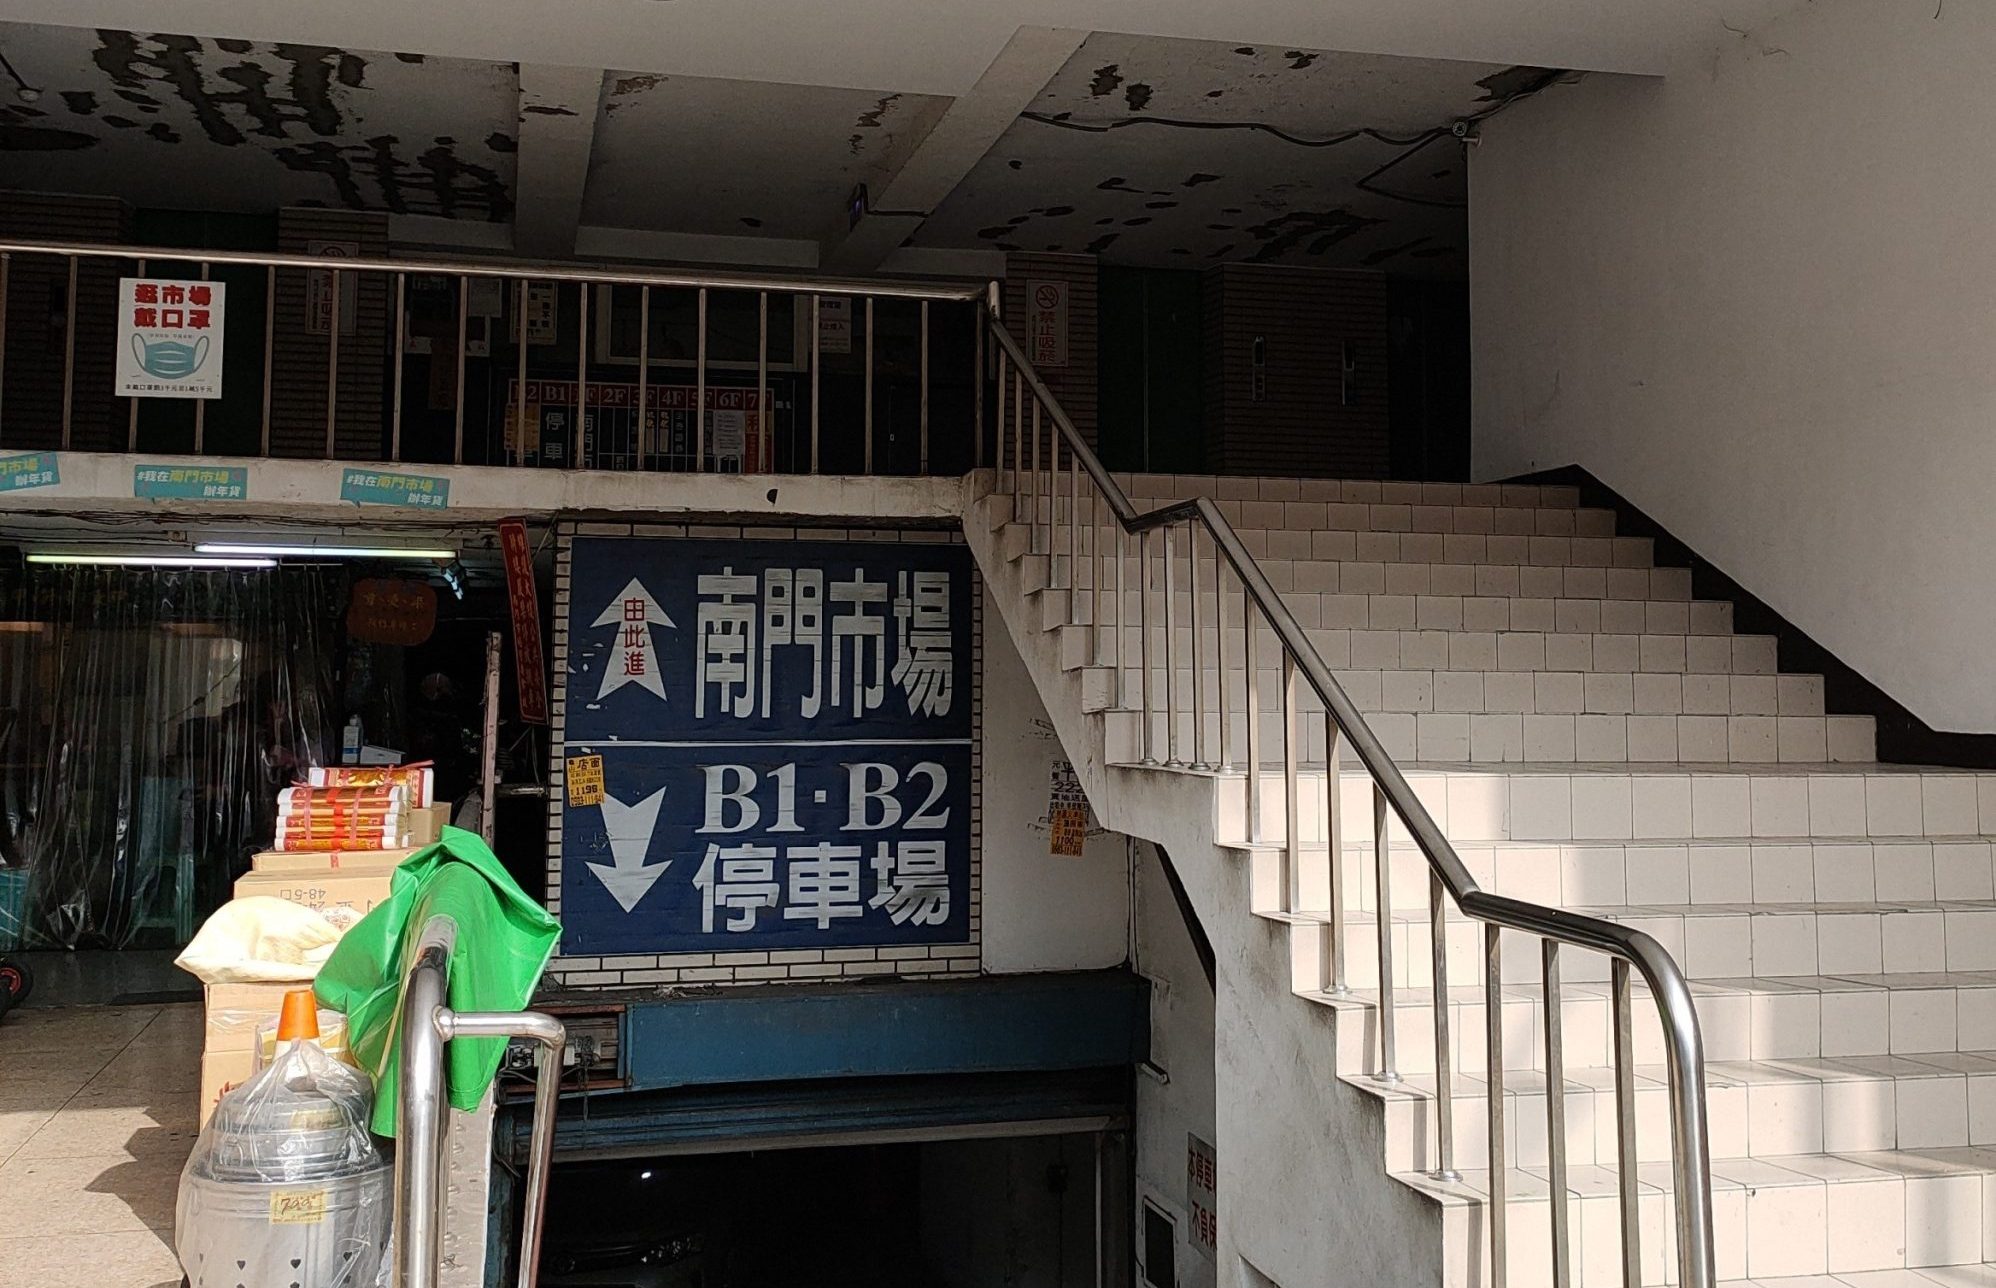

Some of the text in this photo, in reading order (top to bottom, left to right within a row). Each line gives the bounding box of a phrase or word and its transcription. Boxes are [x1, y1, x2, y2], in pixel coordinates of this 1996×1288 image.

[134, 307, 211, 330] 戴口罩
[135, 284, 211, 306] 逛市場
[545, 385, 567, 401] B1
[604, 388, 627, 404] 2F
[719, 392, 743, 408] 6F
[623, 597, 645, 676] 由此進
[695, 566, 952, 719] 南門市場
[692, 841, 950, 933] 停車場
[1188, 1146, 1217, 1195] 本停車
